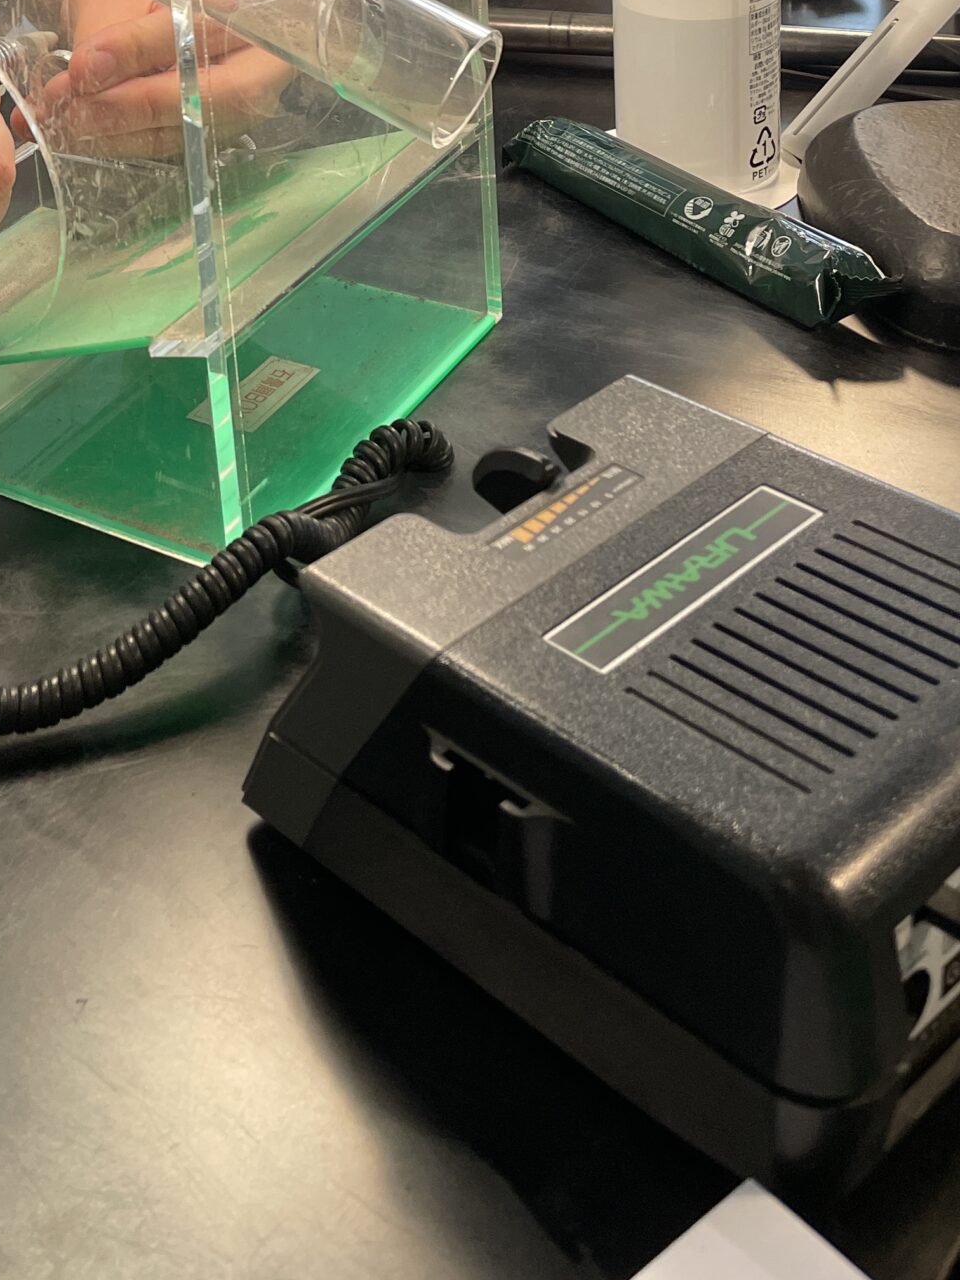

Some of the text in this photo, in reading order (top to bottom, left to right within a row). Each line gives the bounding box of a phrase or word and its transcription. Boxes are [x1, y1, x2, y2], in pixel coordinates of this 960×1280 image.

[762, 139, 767, 156] 1
[752, 166, 768, 181] PET
[611, 525, 758, 622] URAWA
